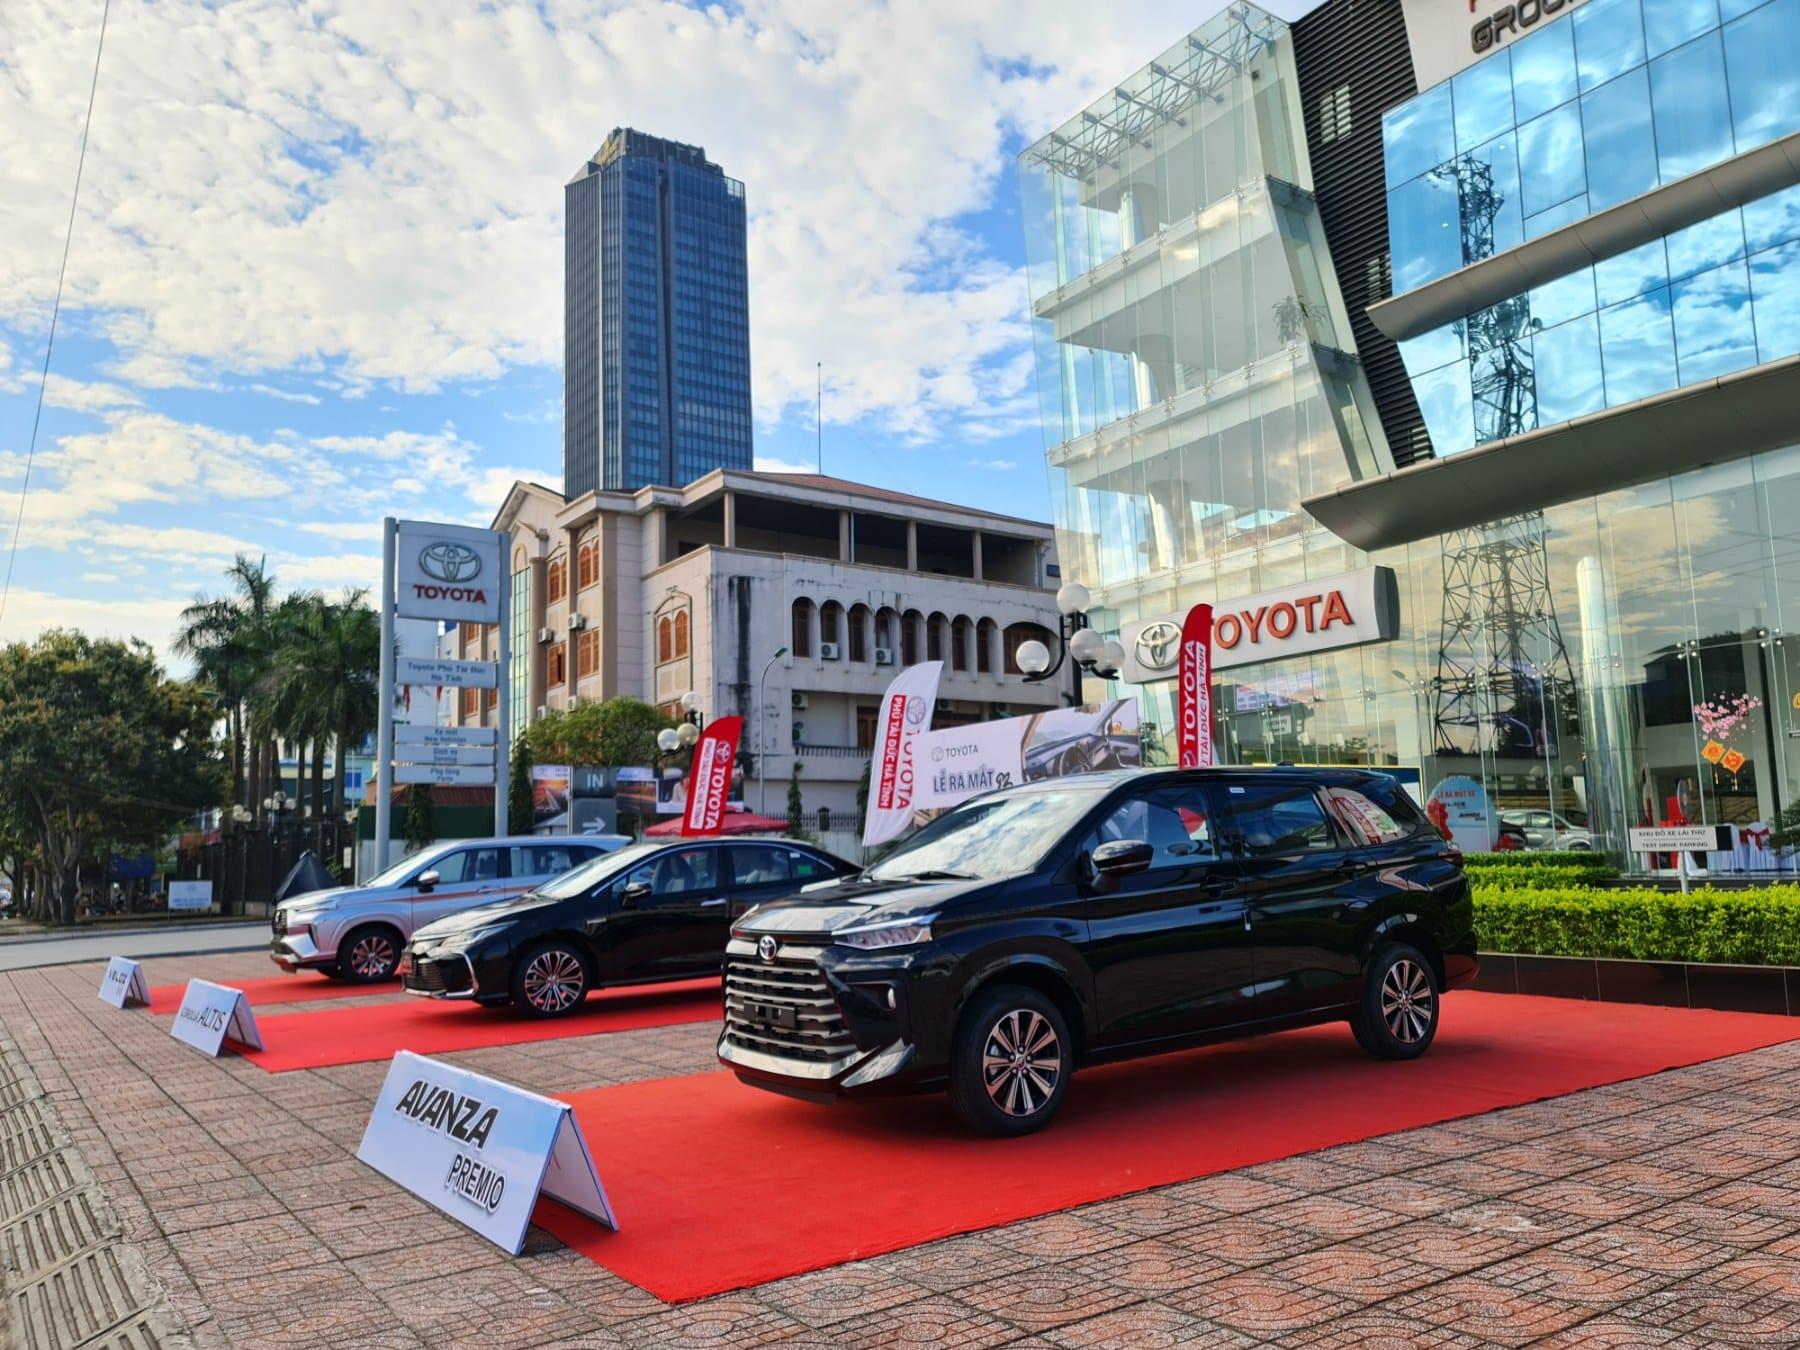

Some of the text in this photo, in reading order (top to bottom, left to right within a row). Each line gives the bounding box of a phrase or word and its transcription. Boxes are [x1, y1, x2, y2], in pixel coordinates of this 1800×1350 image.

[1471, 0, 1574, 53] GROU
[413, 584, 486, 604] TOYOTA
[1211, 590, 1355, 649] OYOTA
[1184, 640, 1197, 745] TOYOTA
[893, 697, 902, 719] PHÚ
[889, 719, 899, 737] TÀI
[946, 744, 978, 758] TOYOTA
[587, 773, 604, 788] IN
[949, 775, 965, 789] RA
[705, 766, 726, 830] TOYOTA
[199, 1005, 226, 1032] ALTIS
[395, 1080, 499, 1149] AVANZA
[447, 1154, 505, 1209] PREMIO
